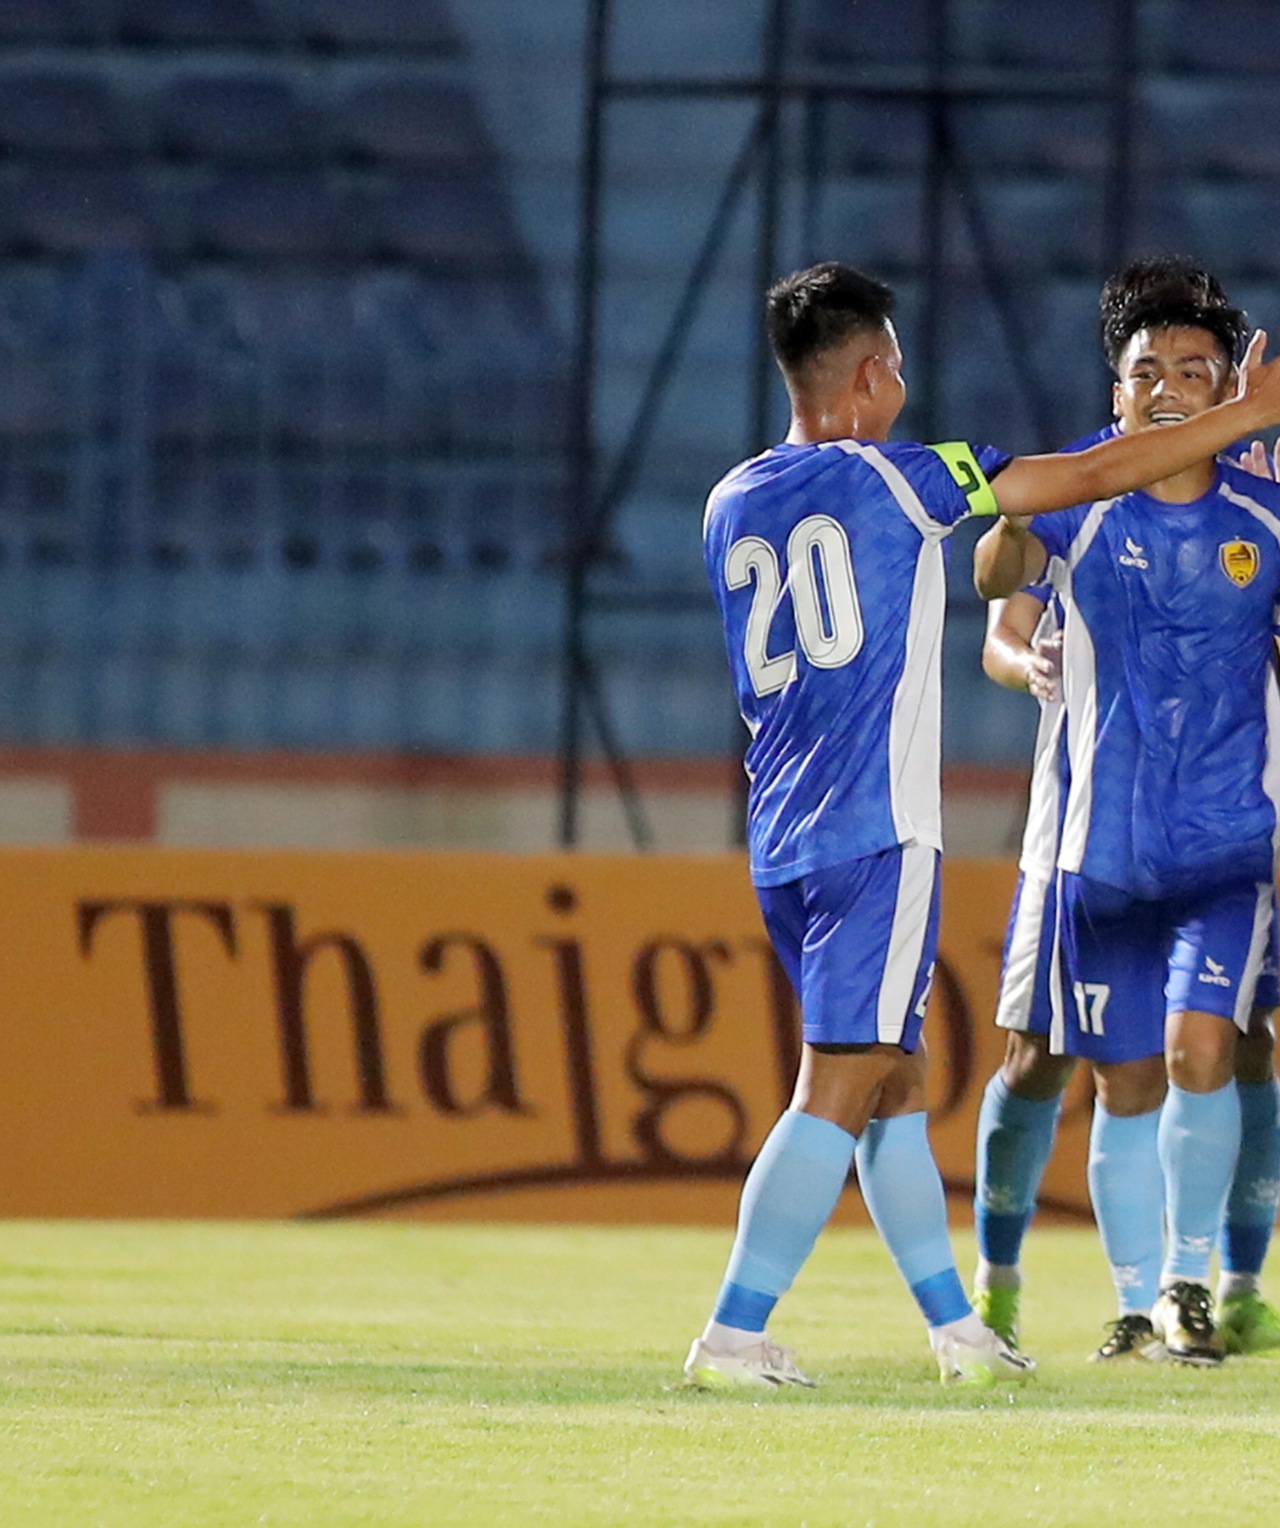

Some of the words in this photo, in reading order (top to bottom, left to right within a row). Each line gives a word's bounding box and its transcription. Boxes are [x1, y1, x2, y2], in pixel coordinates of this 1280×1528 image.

[725, 514, 864, 698] 20
[76, 882, 1095, 1180] Thaig
[1073, 980, 1111, 1036] 17
